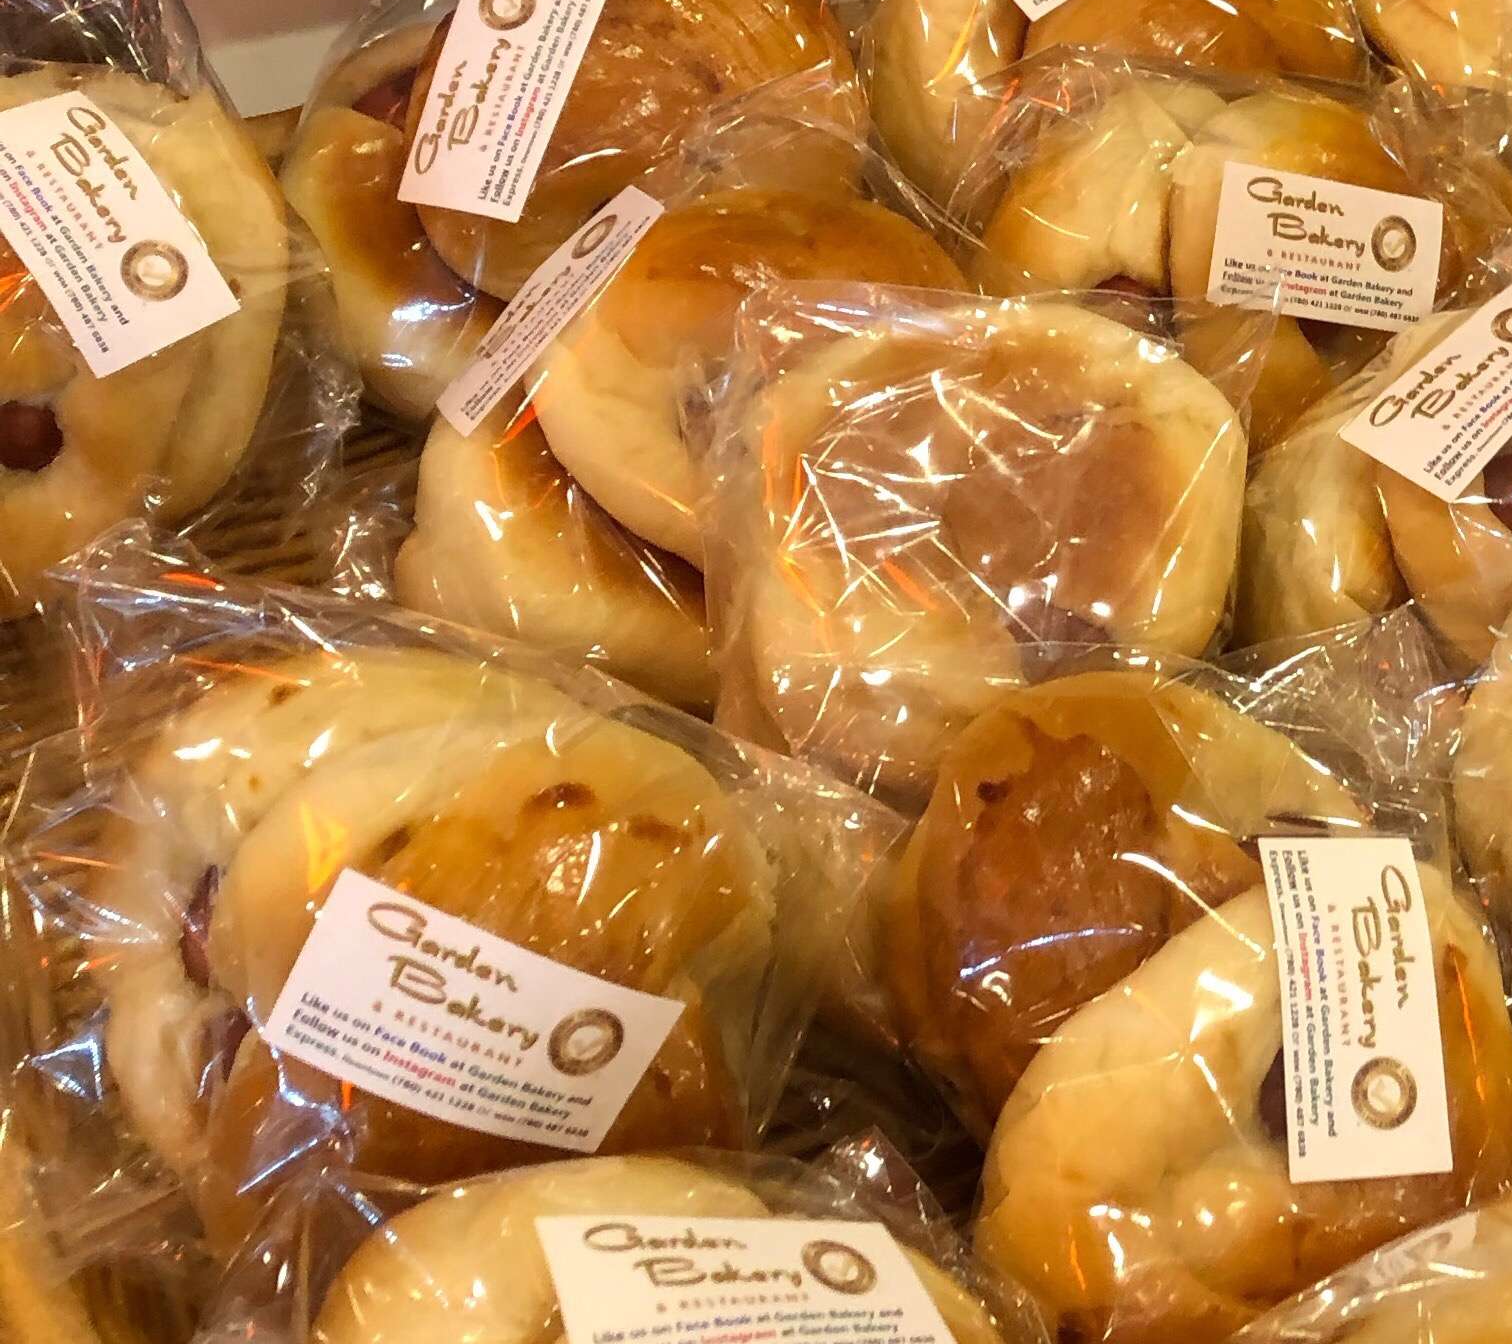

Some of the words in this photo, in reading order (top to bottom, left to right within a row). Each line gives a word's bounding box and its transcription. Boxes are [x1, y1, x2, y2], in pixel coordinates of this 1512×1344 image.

[413, 60, 468, 176] Garden
[446, 37, 512, 151] Bakery
[49, 132, 127, 244] Bakery
[66, 106, 138, 201] Garden
[1246, 176, 1345, 217] Garden
[1266, 211, 1366, 259] Bakery
[1369, 354, 1462, 427] Garden
[1410, 346, 1510, 420] Bakery
[367, 902, 519, 993] Garden
[1351, 896, 1383, 1049] Bakery
[1380, 865, 1416, 1009] Garden
[388, 955, 541, 1053] Bakery
[583, 1222, 747, 1253] Garden
[633, 1256, 803, 1289] Bakery
